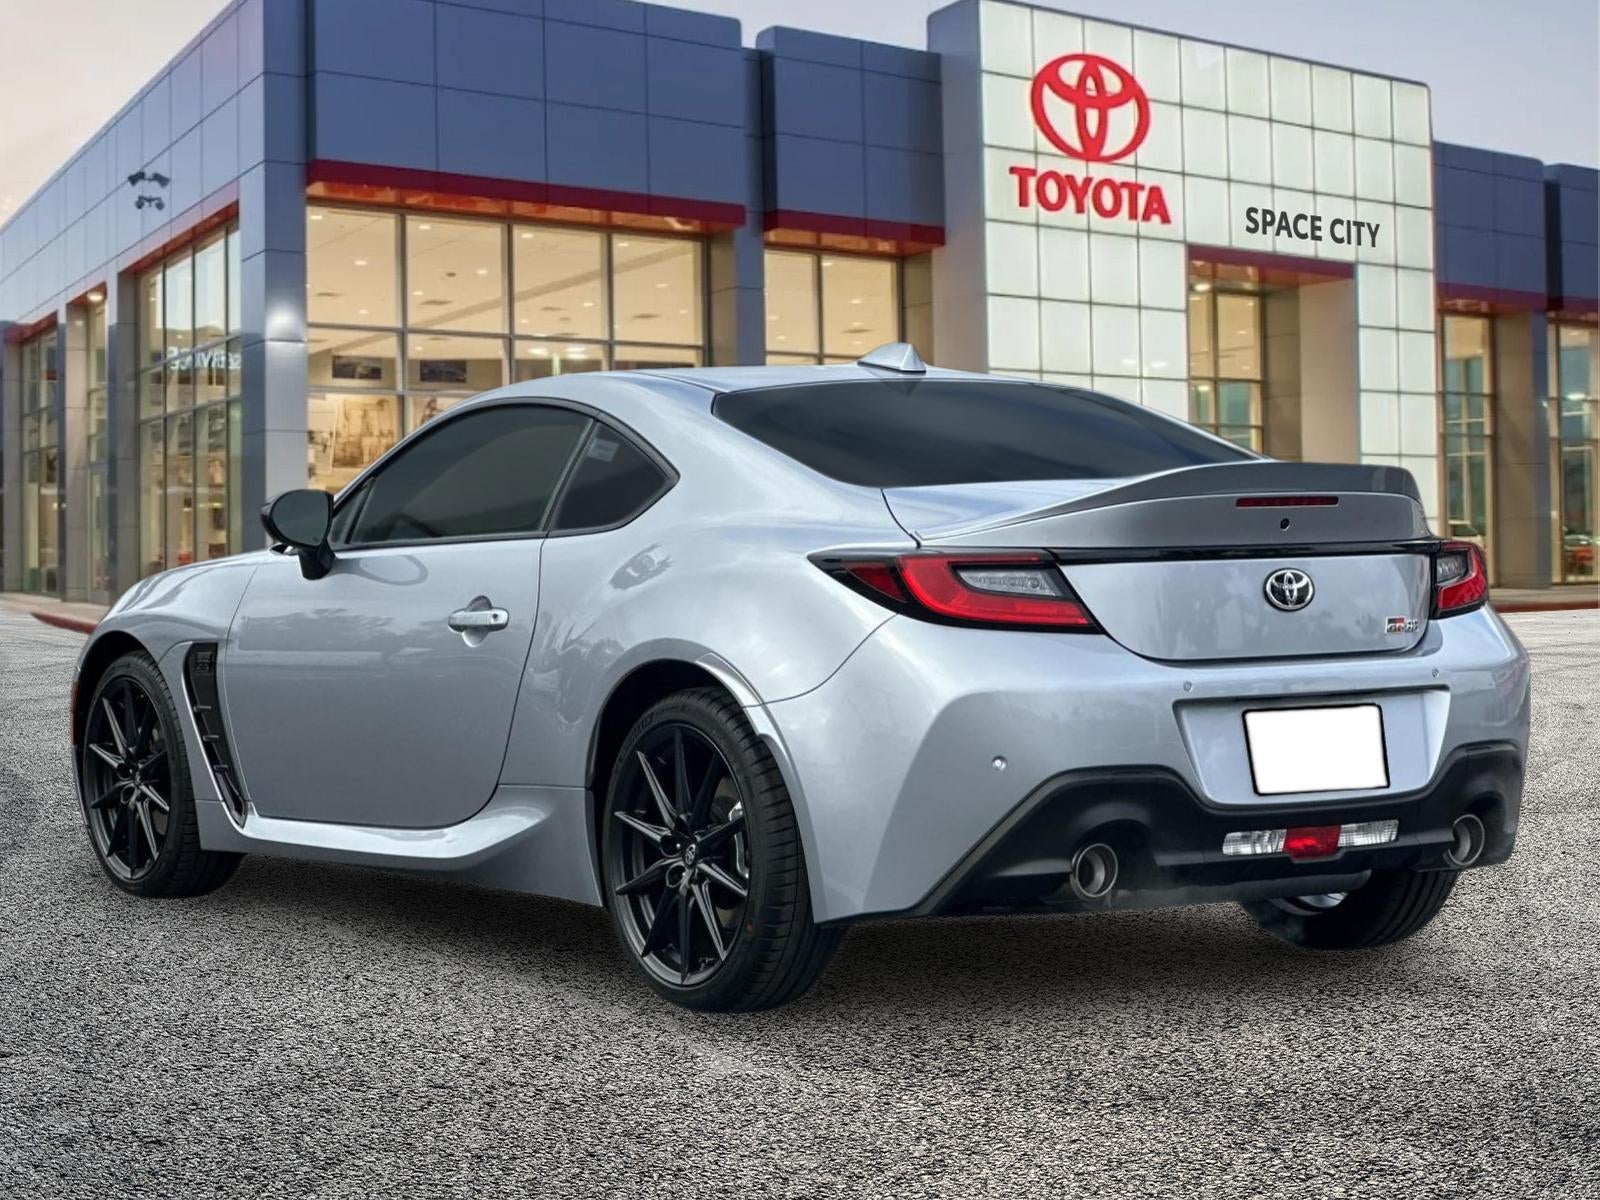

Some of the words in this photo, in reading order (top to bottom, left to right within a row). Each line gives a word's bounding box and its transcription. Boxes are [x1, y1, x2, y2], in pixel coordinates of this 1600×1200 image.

[1009, 166, 1171, 224] TOYOTA
[1245, 206, 1322, 242] SPACE
[1329, 217, 1381, 248] CITY
